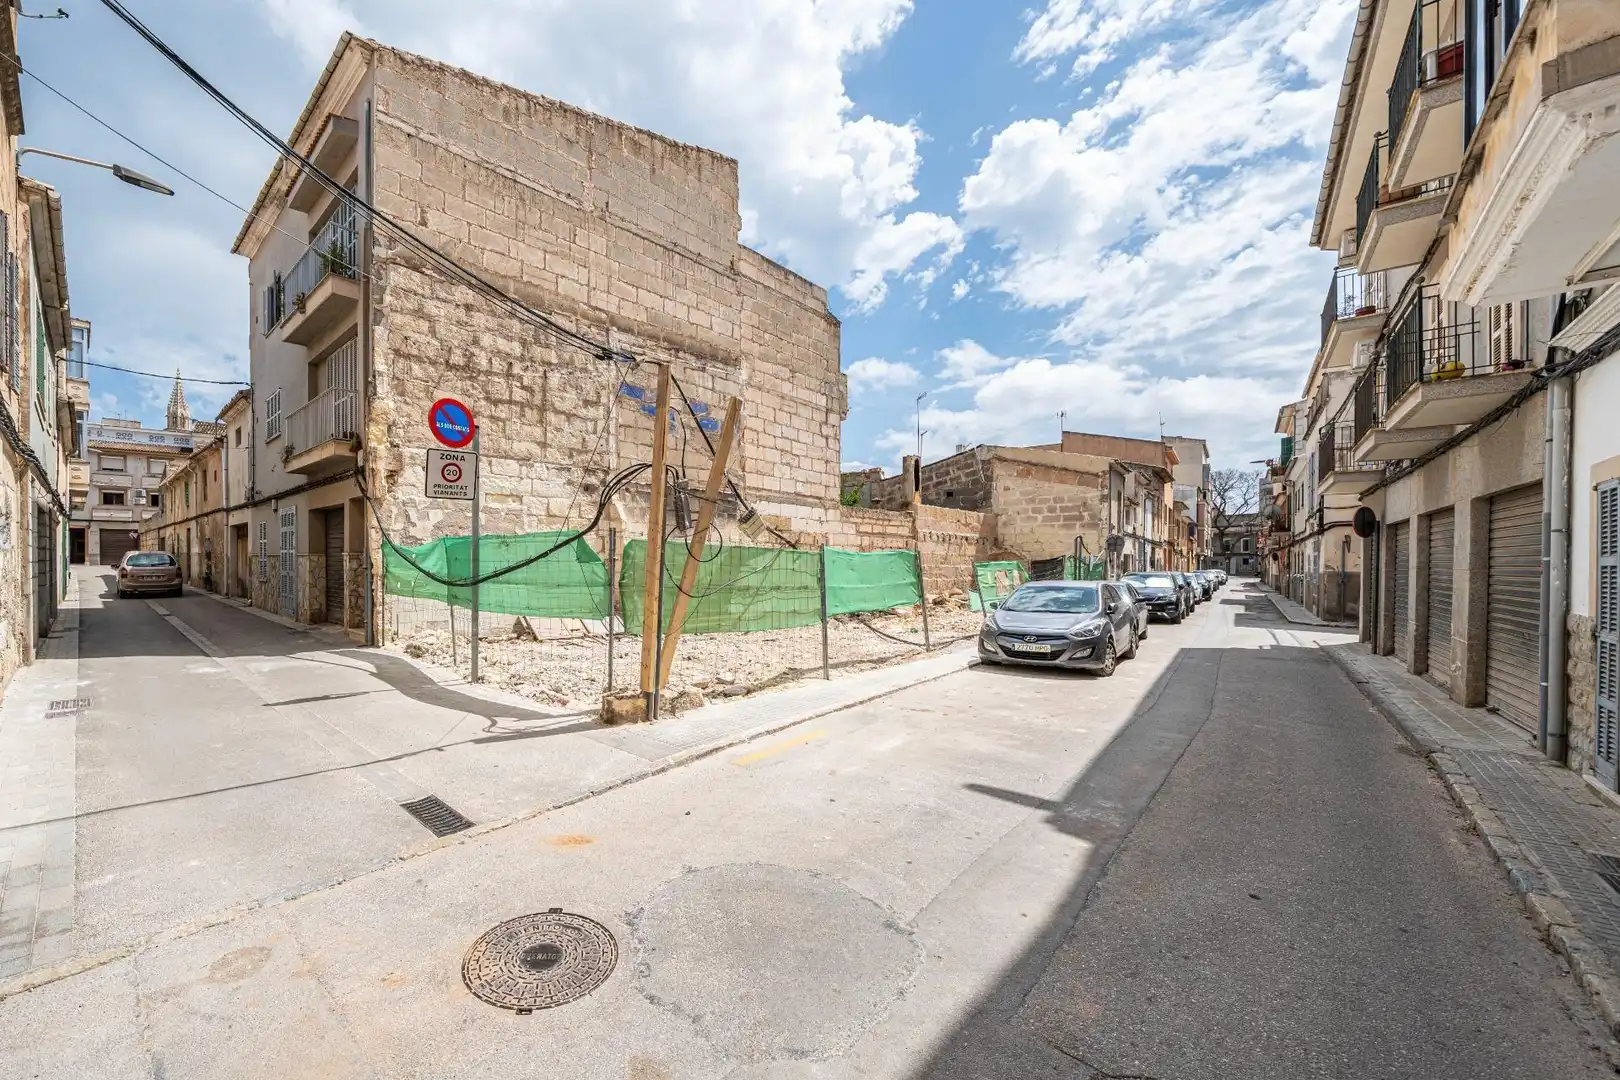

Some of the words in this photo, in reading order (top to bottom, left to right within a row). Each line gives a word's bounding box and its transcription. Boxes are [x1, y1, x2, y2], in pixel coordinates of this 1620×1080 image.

[440, 453, 466, 462] ZONA
[446, 469, 458, 477] 20
[433, 483, 469, 491] PRIORITAT
